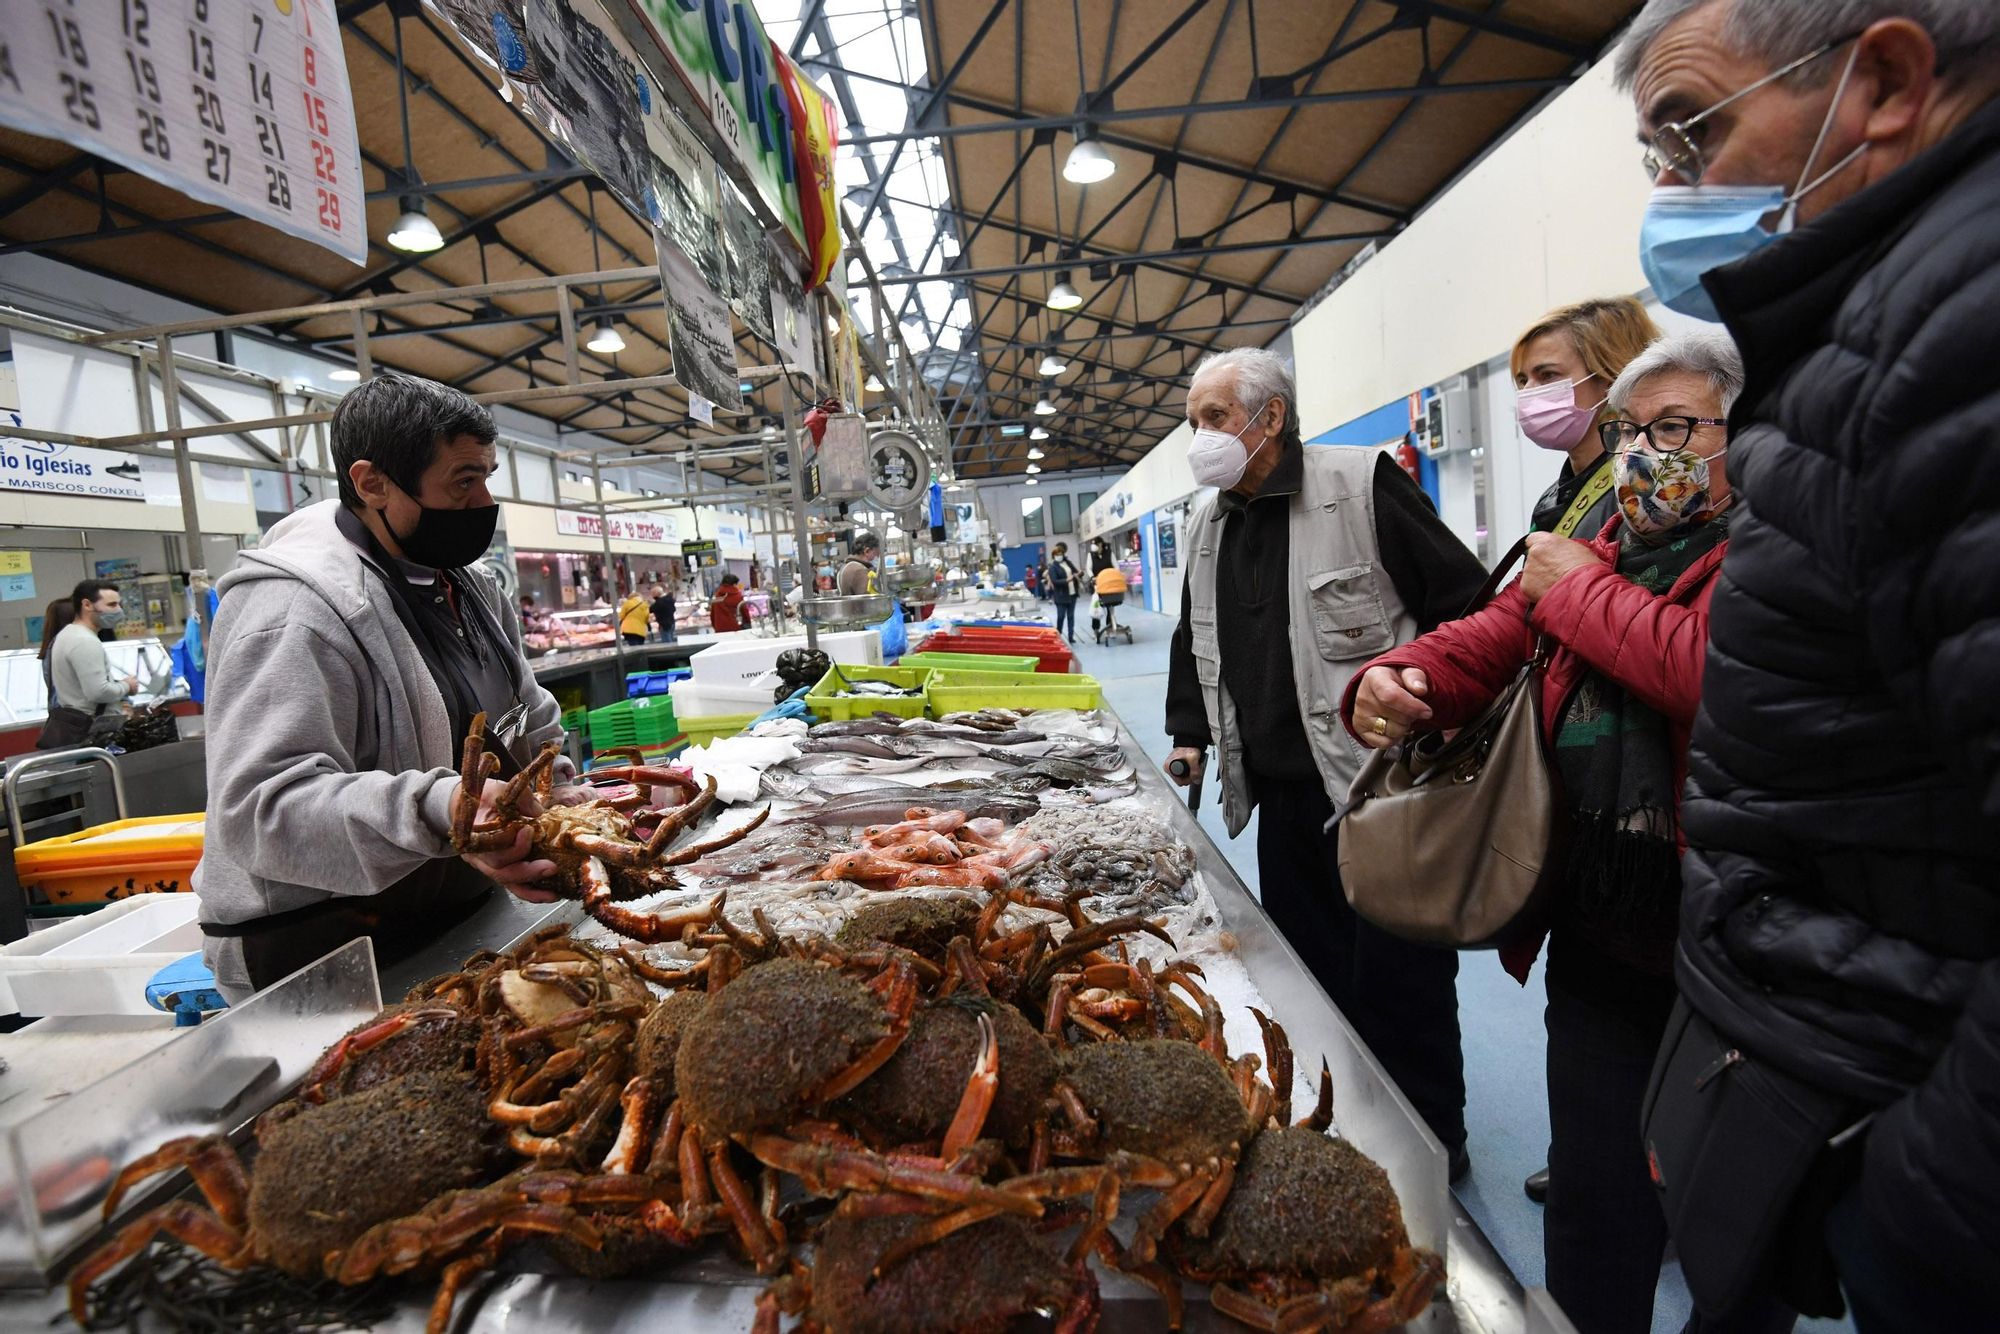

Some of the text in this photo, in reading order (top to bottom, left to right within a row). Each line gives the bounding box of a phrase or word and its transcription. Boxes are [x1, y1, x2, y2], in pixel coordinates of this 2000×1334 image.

[122, 0, 329, 137] 12 13 14 15
[252, 13, 263, 53] 7
[304, 46, 317, 87] 8
[46, 8, 338, 185] 18 19 20 21 22
[714, 91, 739, 149] 1192
[59, 72, 102, 131] 25
[137, 107, 171, 162] 26
[203, 138, 231, 185] 27
[265, 164, 292, 210] 28
[317, 187, 341, 232] 29
[8, 479, 85, 492] MARISCOS
[25, 454, 92, 476] Iglesias
